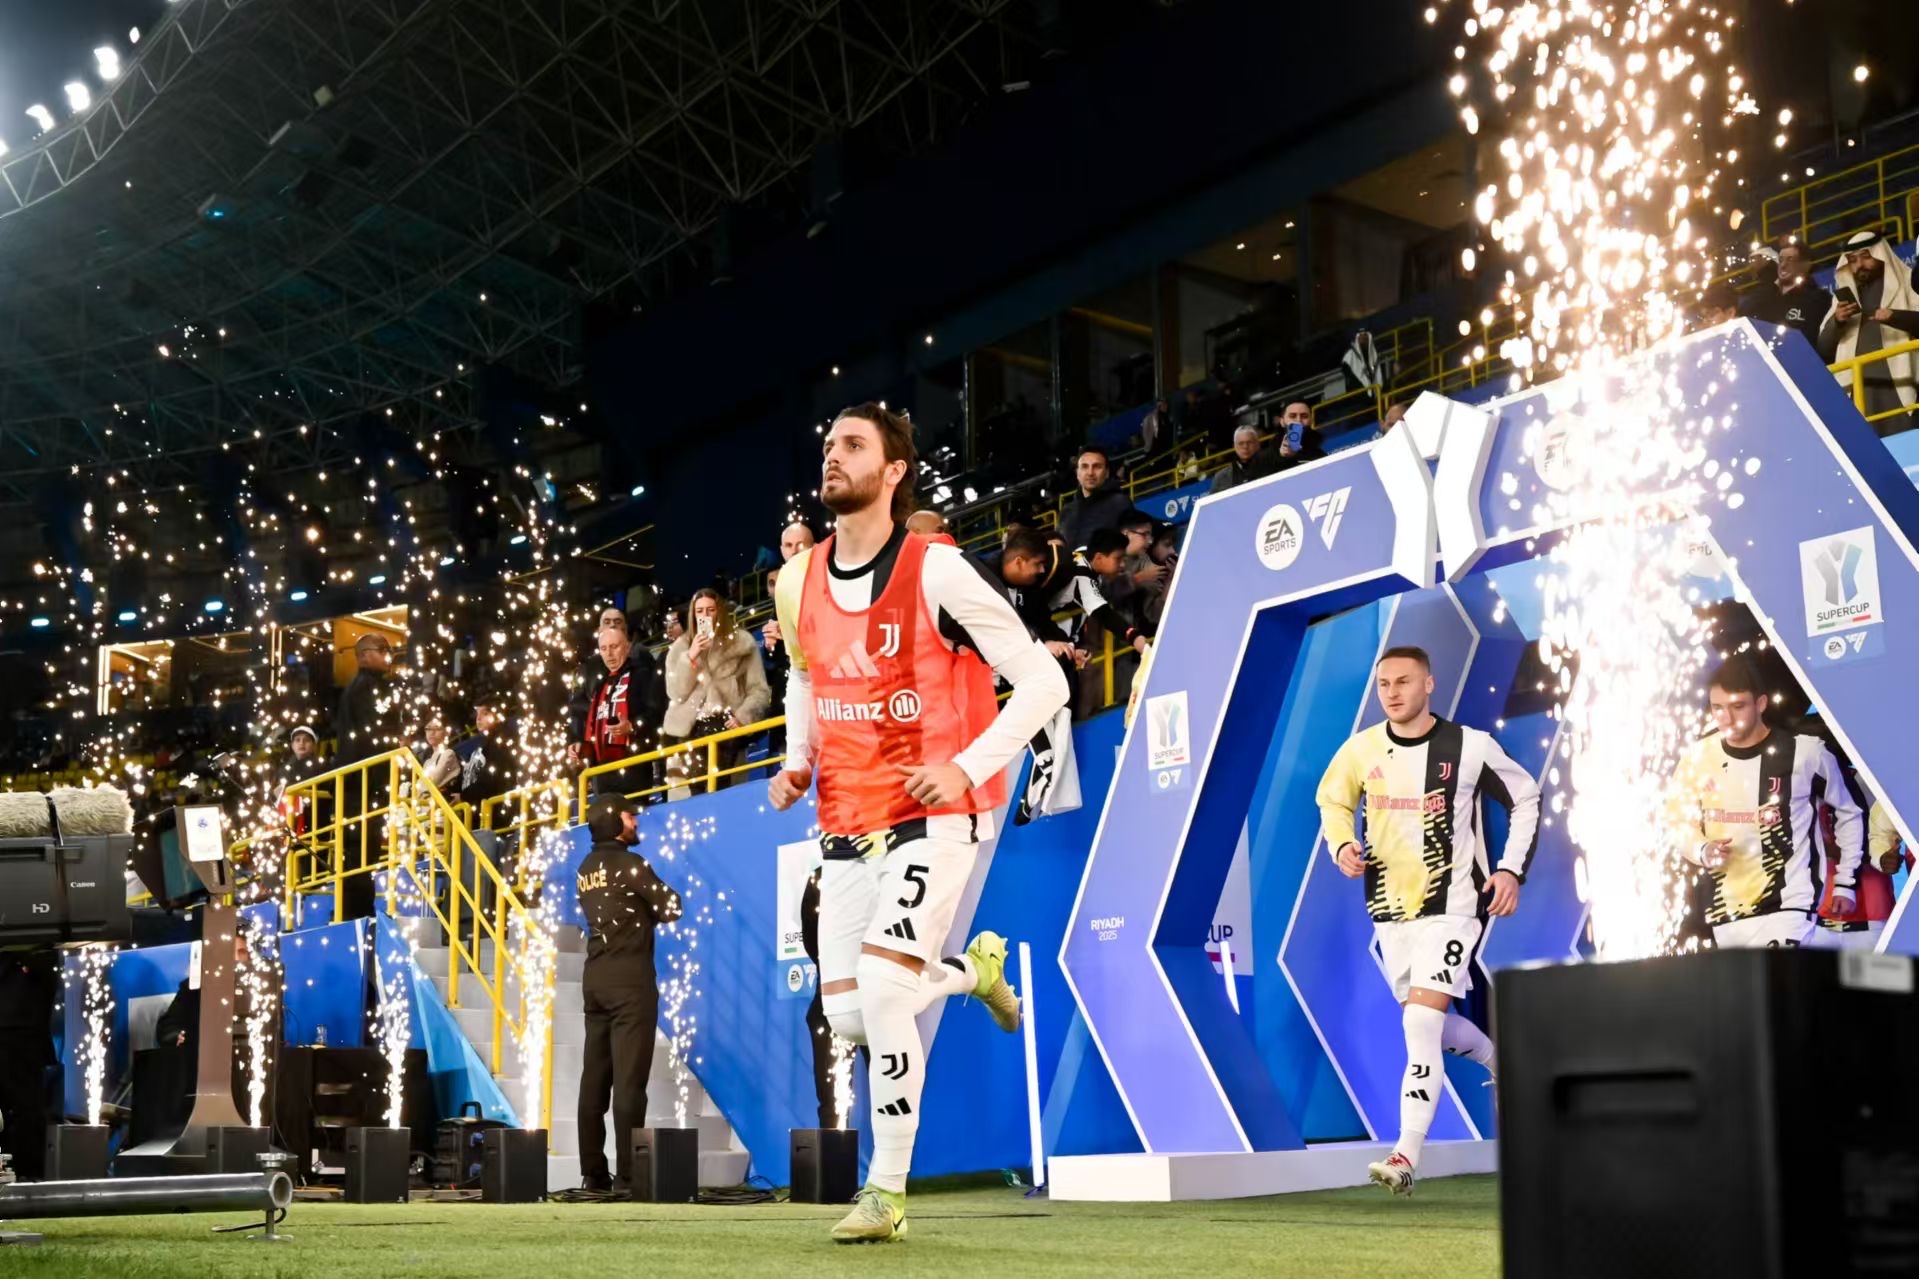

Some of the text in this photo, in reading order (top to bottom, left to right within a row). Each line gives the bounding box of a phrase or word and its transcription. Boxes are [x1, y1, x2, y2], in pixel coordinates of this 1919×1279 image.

[1264, 518, 1294, 544] EA
[1264, 538, 1296, 555] SPORTS
[1816, 602, 1870, 622] SUPERCUP
[817, 697, 884, 721] Allianz
[898, 864, 929, 909] 5
[32, 903, 50, 914] HD
[1090, 916, 1125, 931] RIYADH
[784, 932, 804, 944] SUPE
[1099, 930, 1117, 941] 2025
[1205, 925, 1233, 943] UP
[1444, 940, 1464, 966] 8
